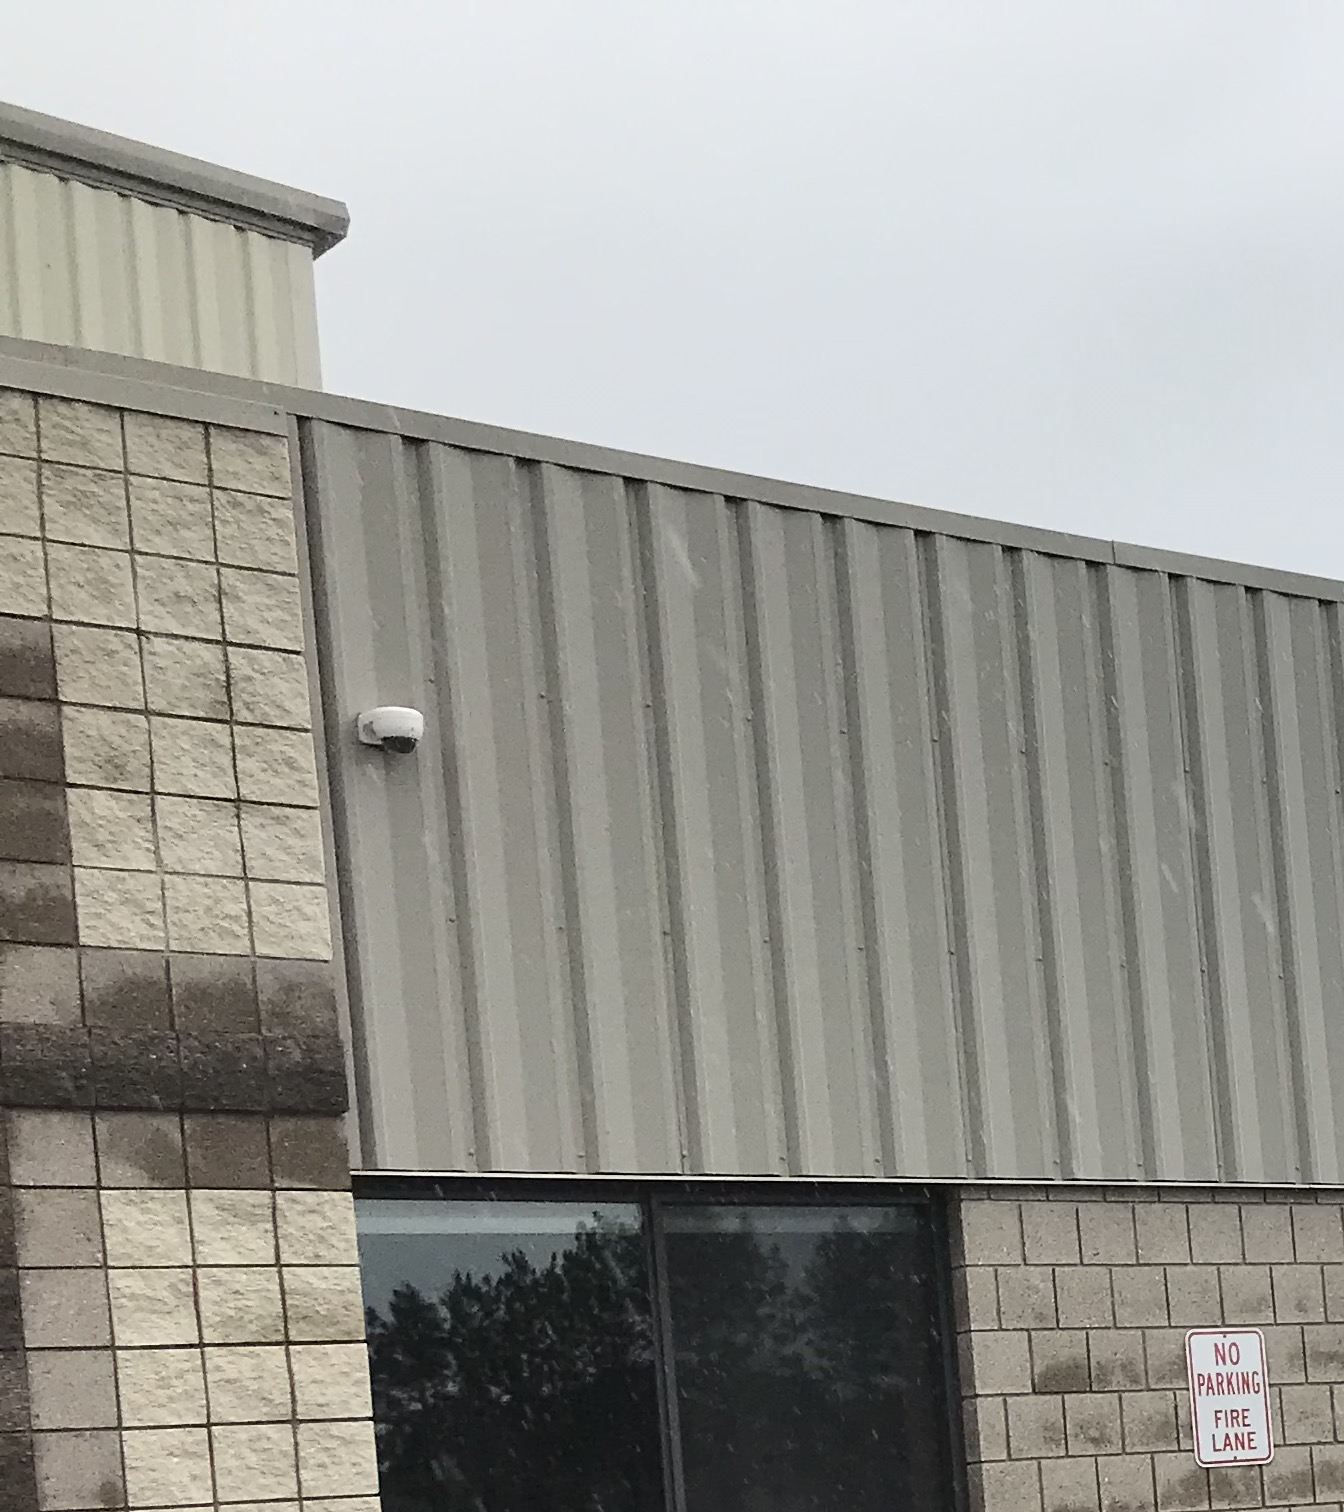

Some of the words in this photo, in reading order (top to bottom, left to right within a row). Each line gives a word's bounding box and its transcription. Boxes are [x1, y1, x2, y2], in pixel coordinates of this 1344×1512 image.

[1213, 1342, 1241, 1366] NO
[1197, 1371, 1261, 1396] PARKING
[1214, 1408, 1251, 1429] FIRE
[1211, 1431, 1258, 1453] LANE
